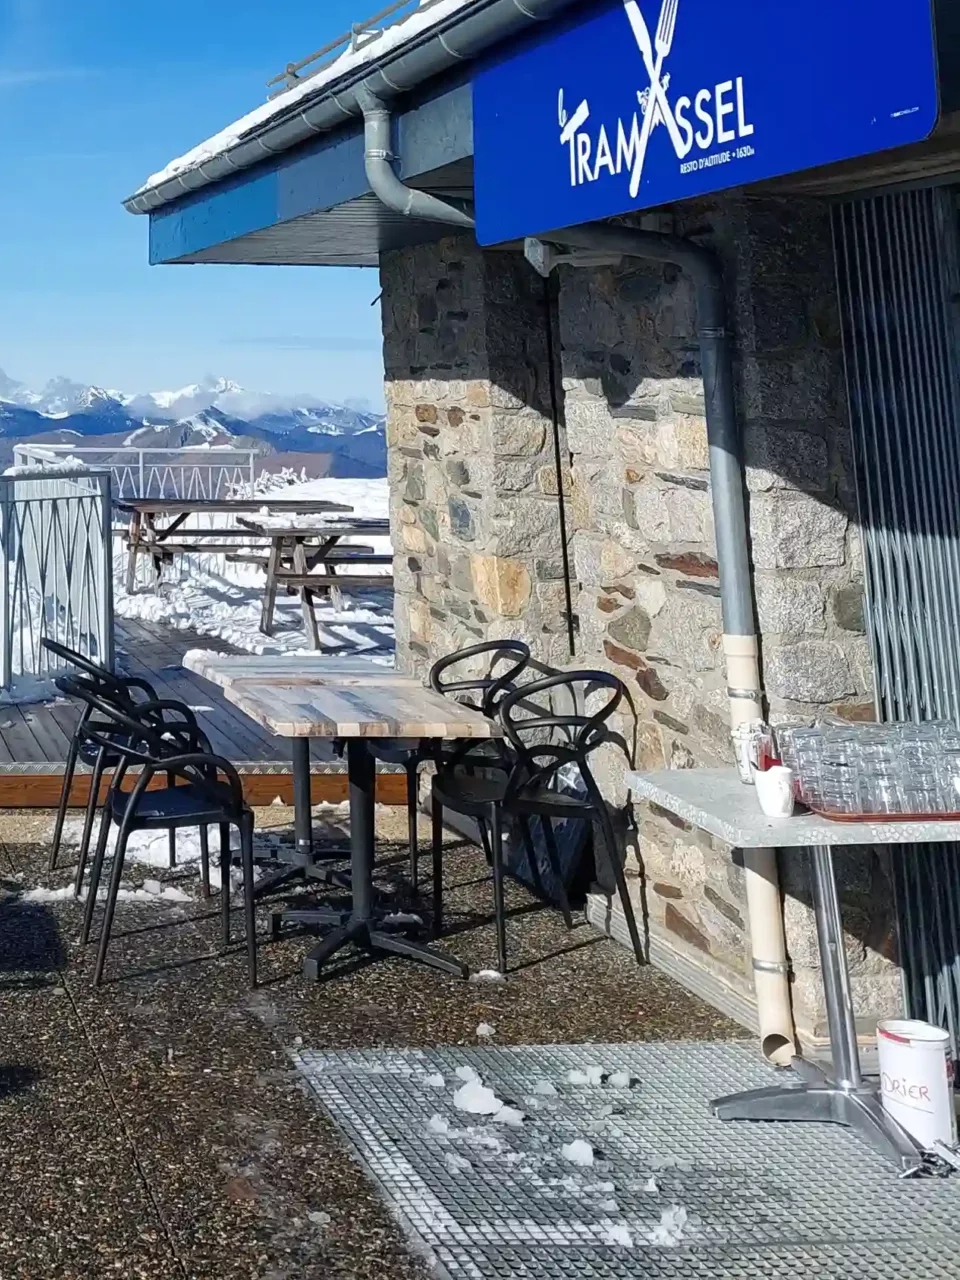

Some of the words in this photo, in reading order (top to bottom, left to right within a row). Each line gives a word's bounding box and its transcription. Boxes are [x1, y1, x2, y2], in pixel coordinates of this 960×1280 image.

[560, 76, 754, 198] TRAMASSEL
[680, 160, 698, 174] RESTO
[699, 151, 731, 169] D'ALTITUDE
